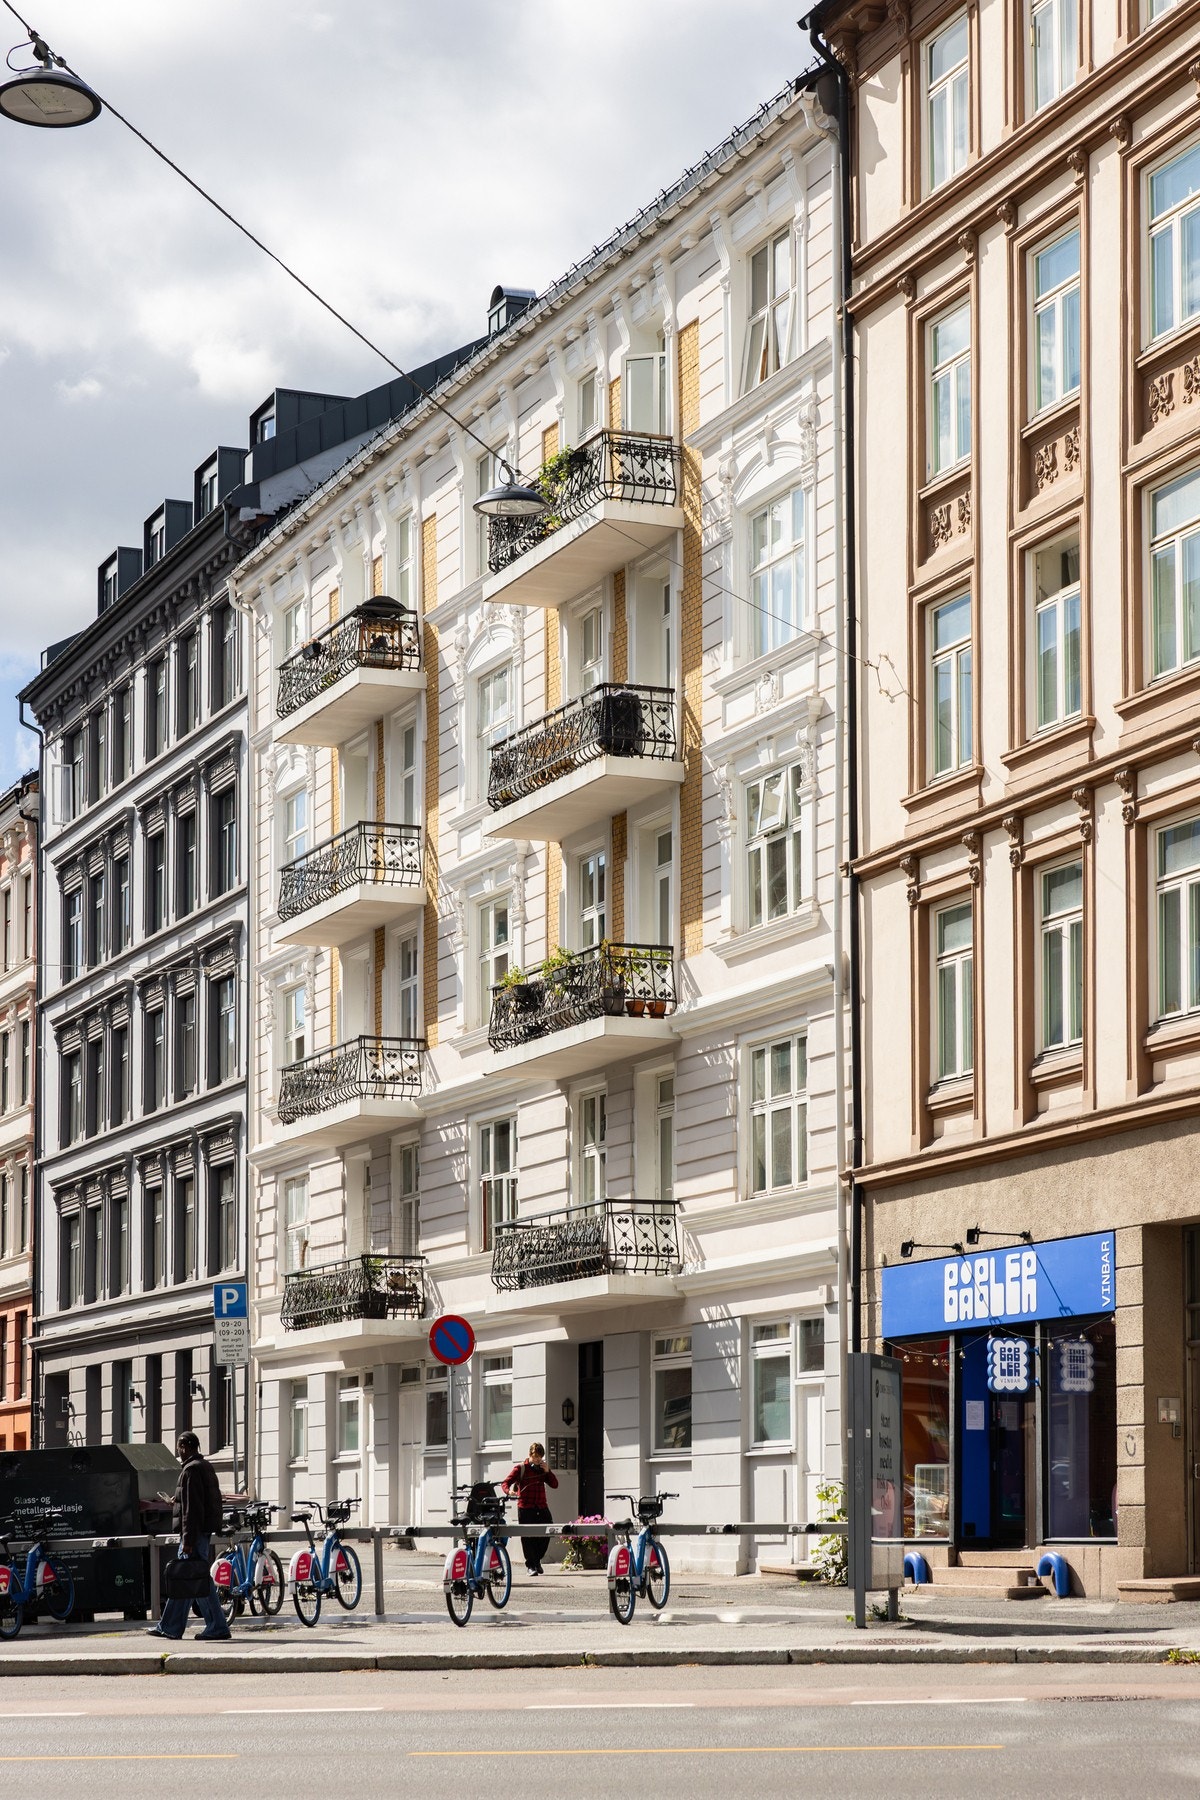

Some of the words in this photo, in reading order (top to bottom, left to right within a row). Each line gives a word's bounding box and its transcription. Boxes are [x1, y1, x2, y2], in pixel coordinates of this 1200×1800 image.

[1101, 1240, 1110, 1307] VINBAR
[221, 1288, 239, 1314] P
[40, 1496, 51, 1504] og
